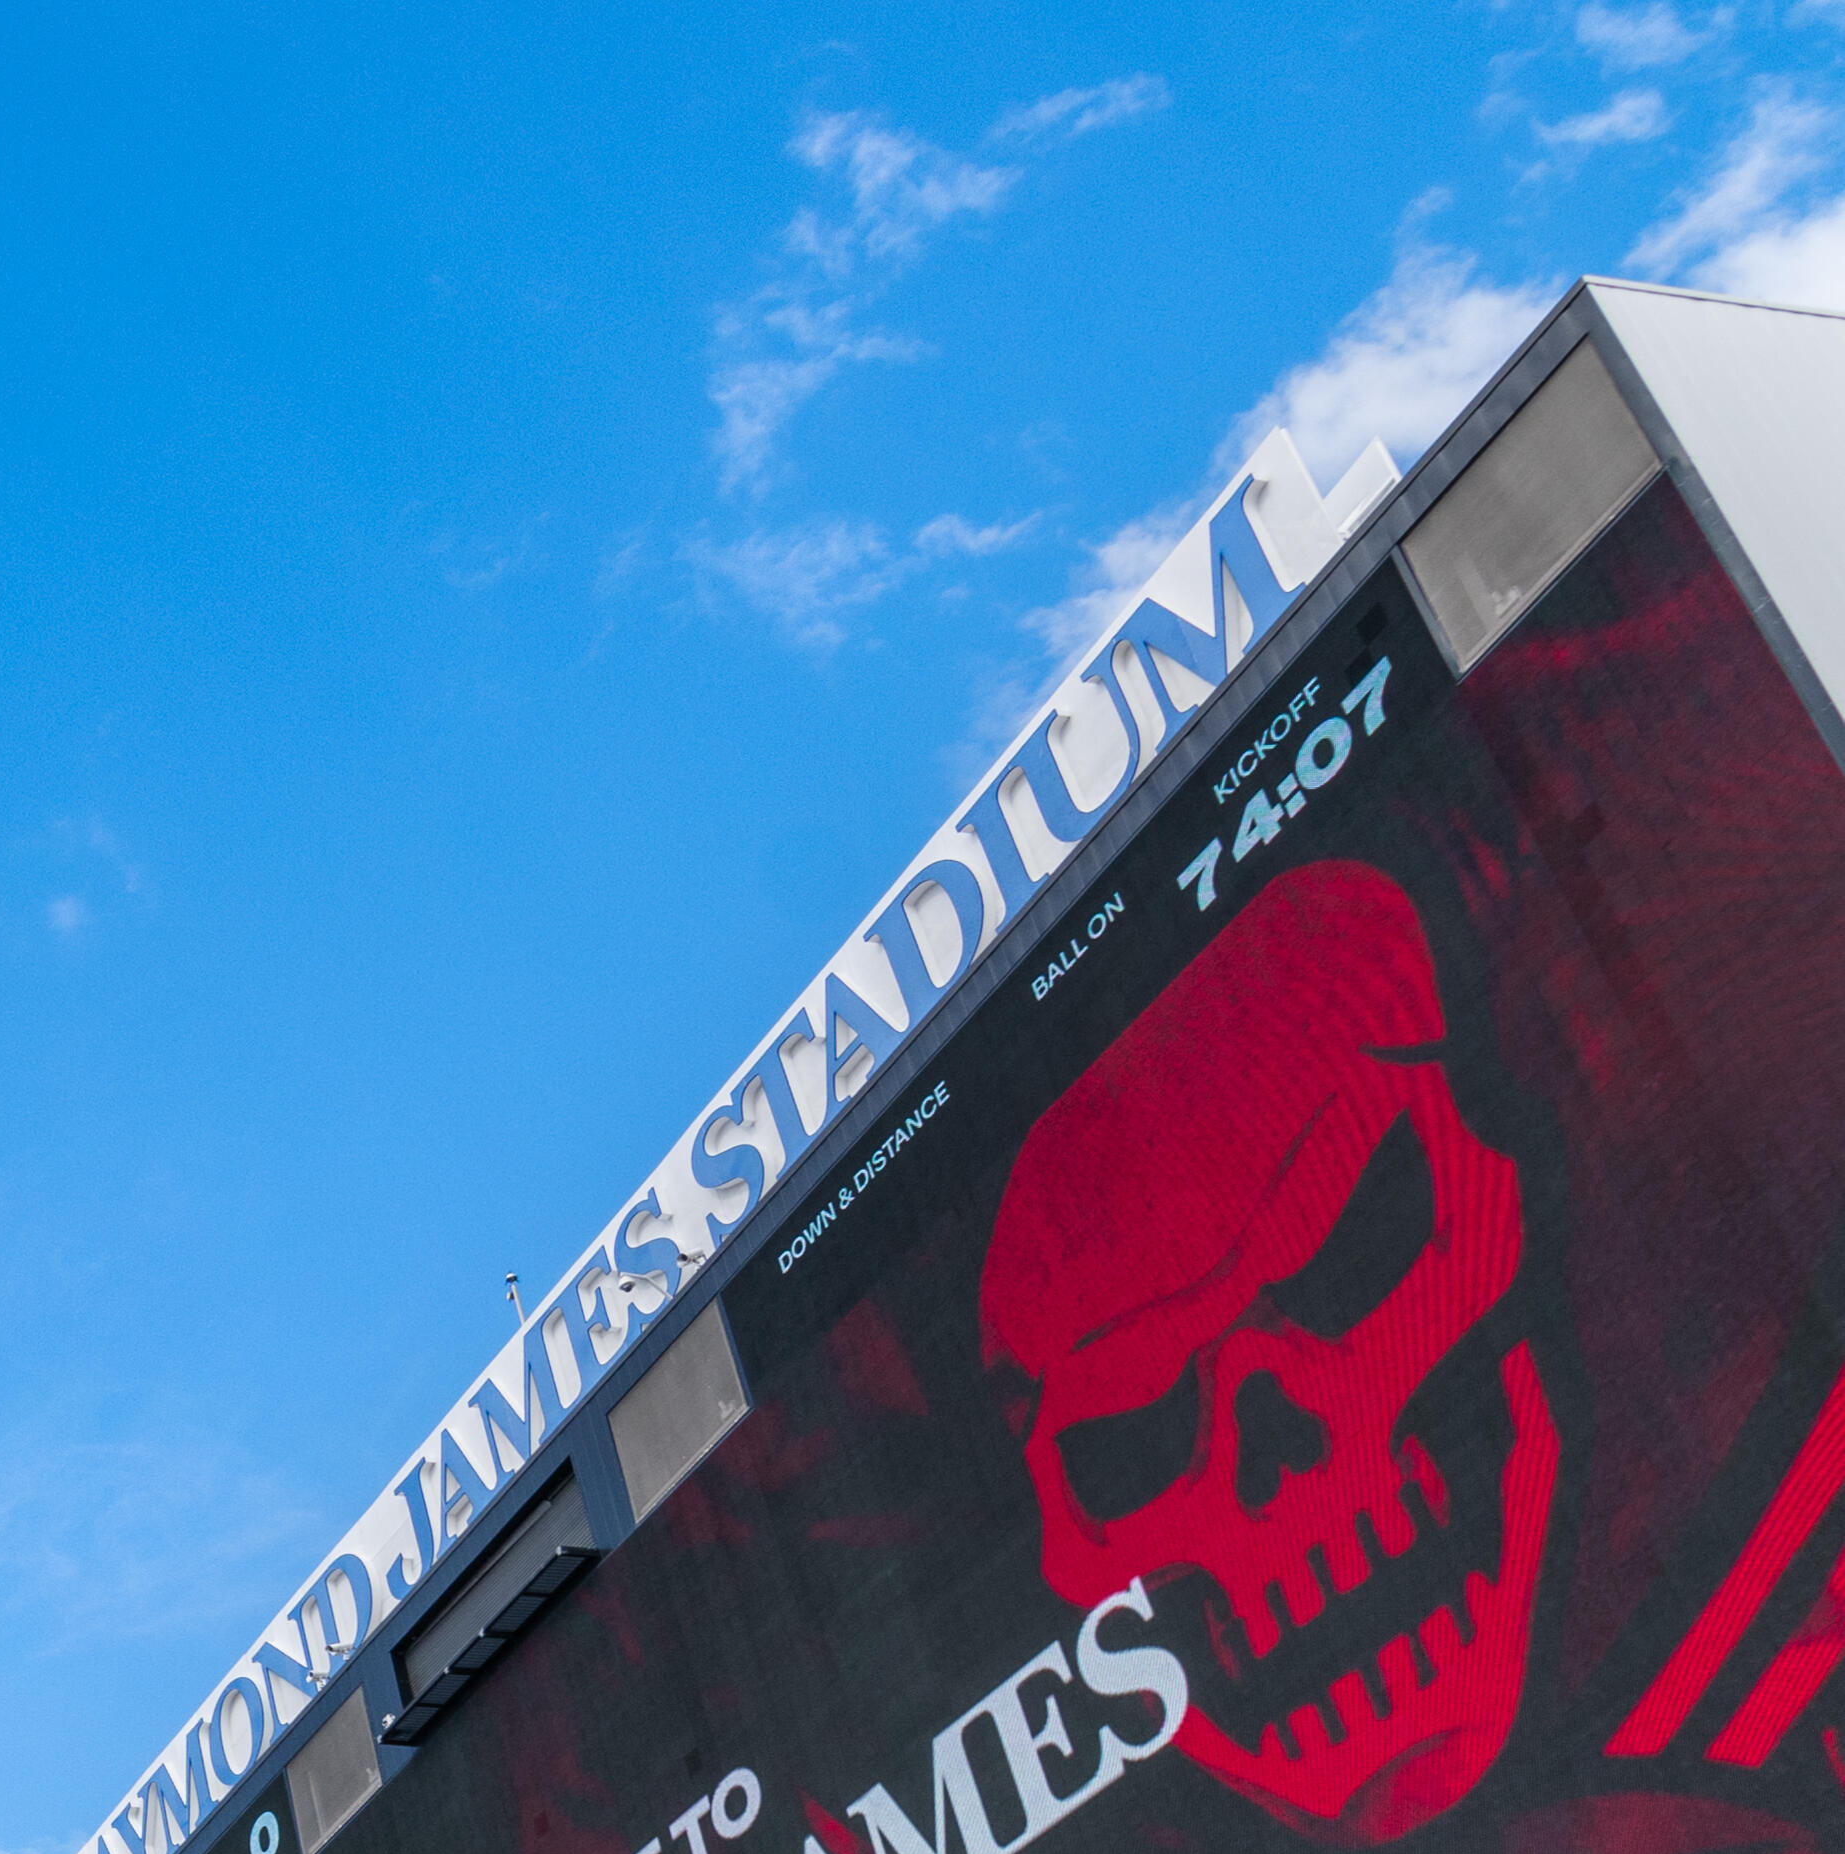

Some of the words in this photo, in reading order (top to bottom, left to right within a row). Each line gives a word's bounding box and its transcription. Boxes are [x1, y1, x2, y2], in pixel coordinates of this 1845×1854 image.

[1176, 656, 1393, 912] 74:07
[1212, 676, 1323, 805] KICKOFF
[391, 1188, 684, 1598] JAMES
[691, 474, 1309, 1247] STADIUM
[1031, 933, 1088, 1001] BALL
[1087, 893, 1126, 942] ON
[776, 1202, 836, 1275] DOWN
[854, 1079, 952, 1193] DISTANCE
